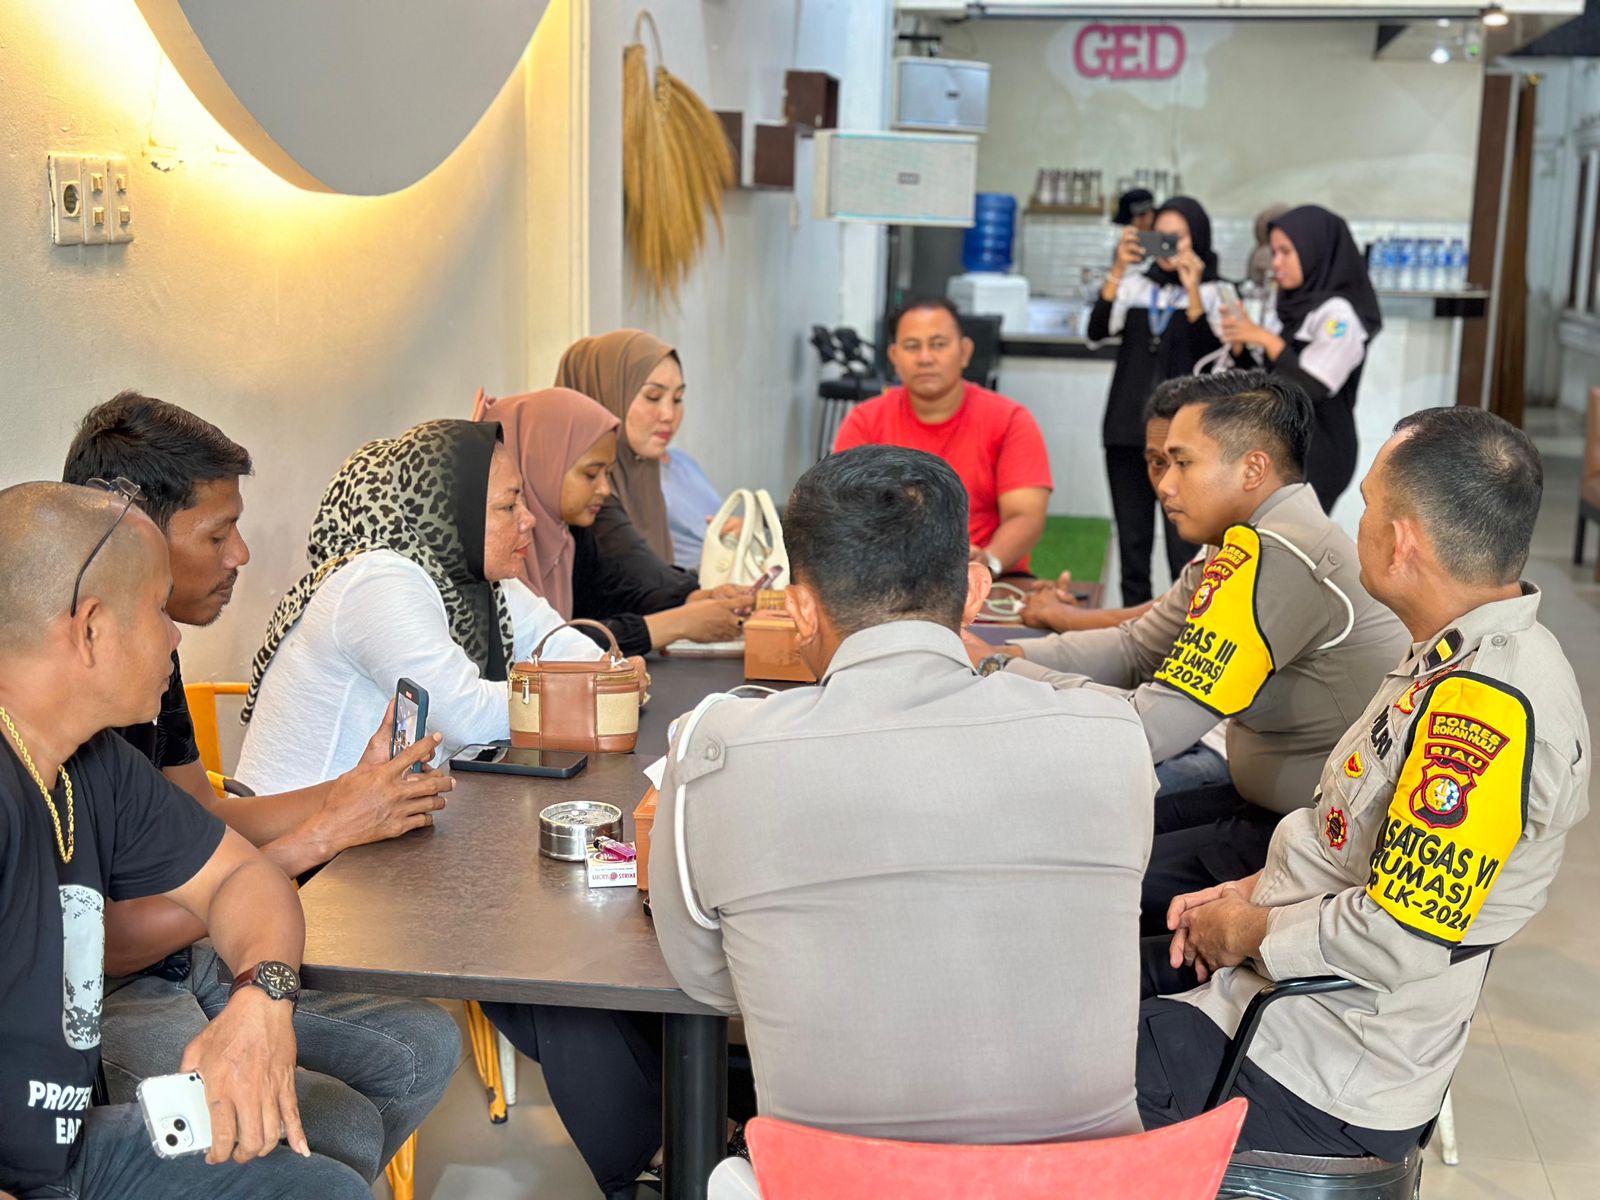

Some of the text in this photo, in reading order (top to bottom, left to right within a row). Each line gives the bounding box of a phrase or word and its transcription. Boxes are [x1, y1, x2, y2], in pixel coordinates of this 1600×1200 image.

[1073, 23, 1186, 80] GED
[1214, 639, 1237, 665] III
[1432, 725, 1497, 754] ROKAN HULU
[1434, 715, 1502, 746] POLRES
[1430, 746, 1483, 768] RIAU
[1383, 819, 1499, 889] SATGAS VI
